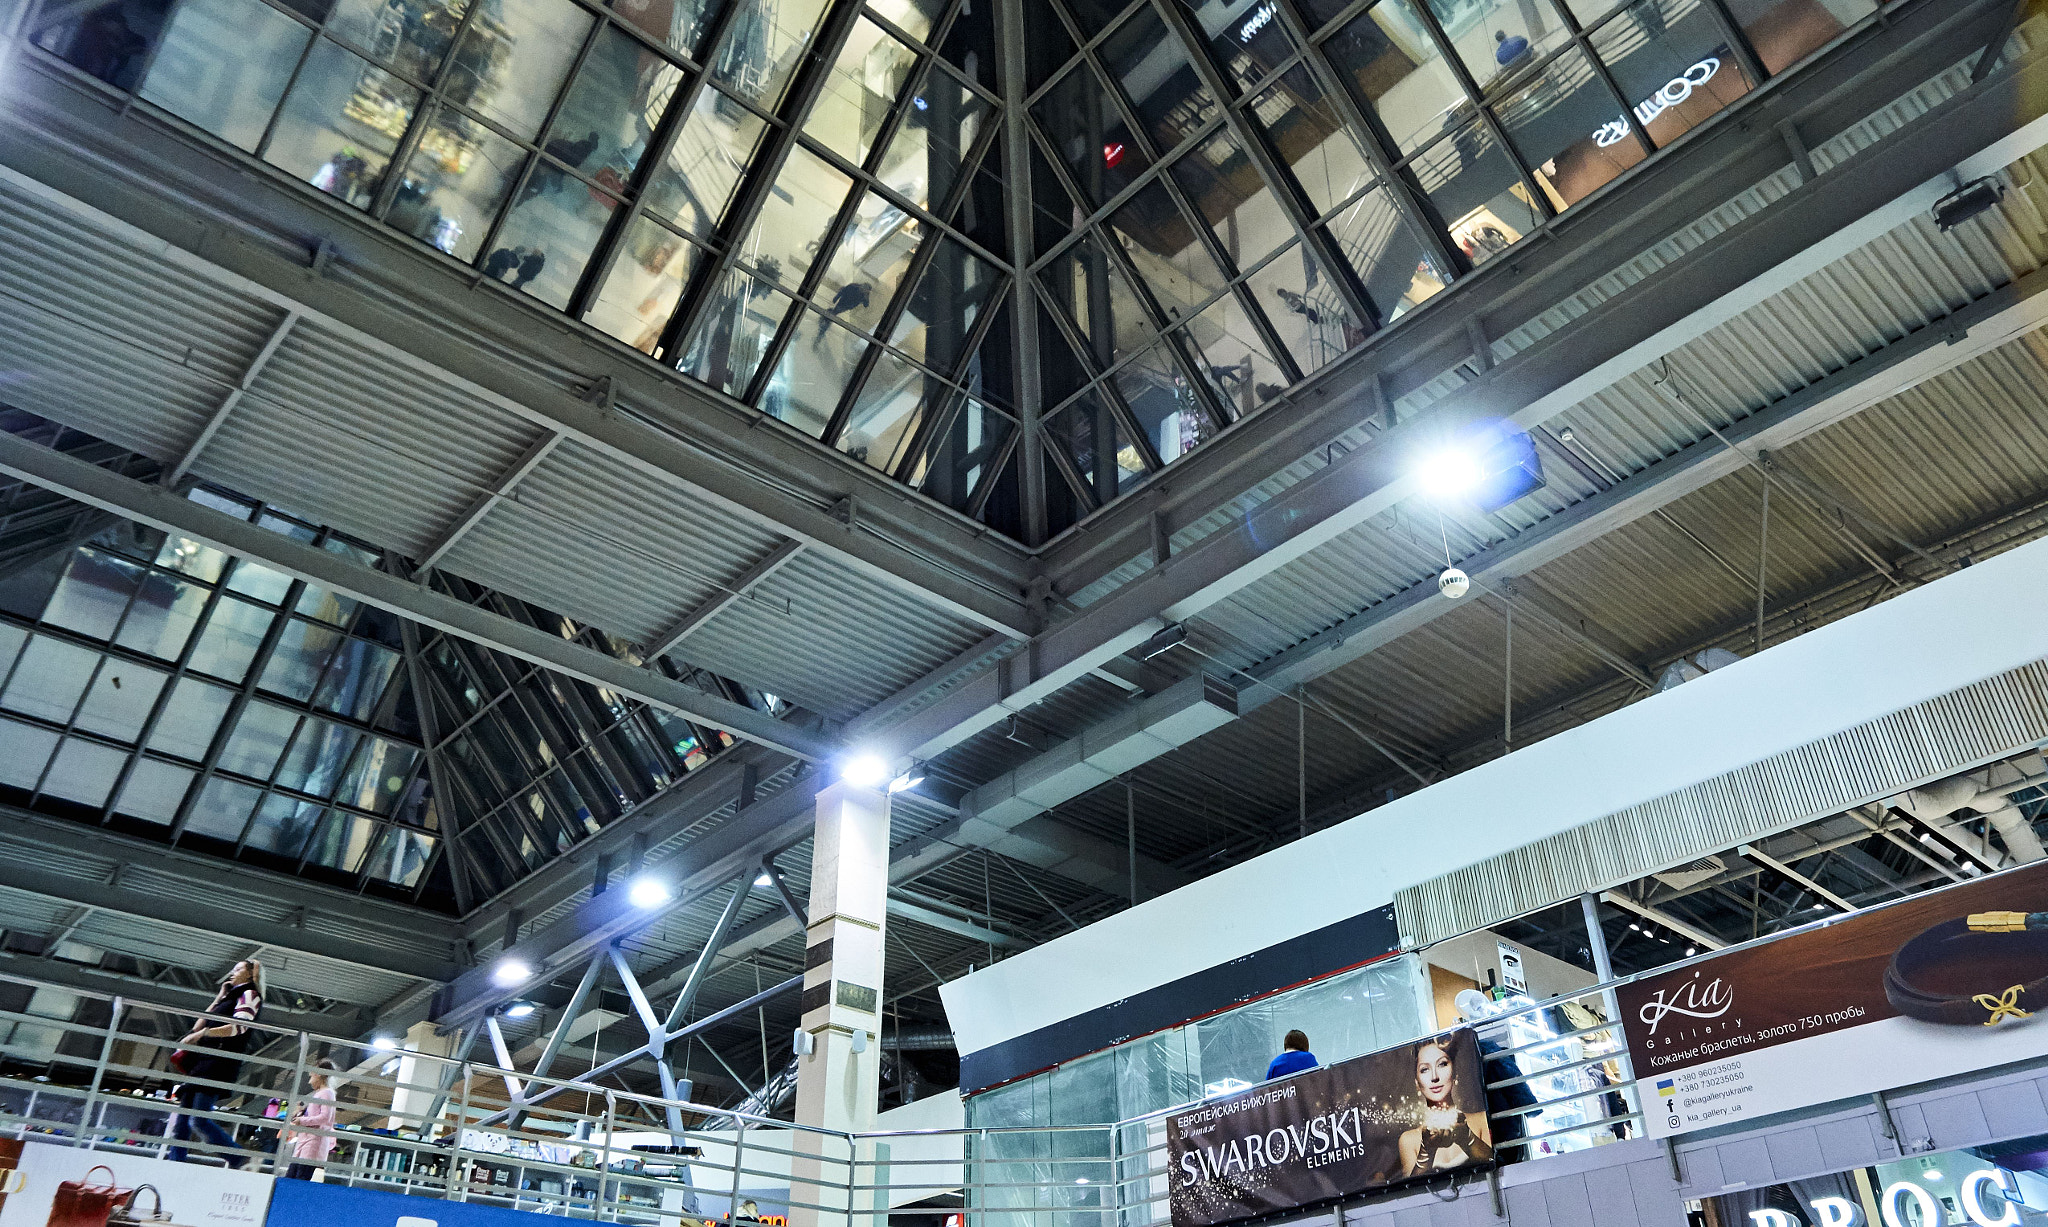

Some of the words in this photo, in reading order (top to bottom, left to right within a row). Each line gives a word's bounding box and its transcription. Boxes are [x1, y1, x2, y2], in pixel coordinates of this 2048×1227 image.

[1640, 971, 1733, 1036] Kia
[1646, 1018, 1741, 1049] Gallery
[1650, 1047, 1700, 1068] Кожаные
[1701, 1033, 1756, 1055] браслеты,
[1757, 1022, 1797, 1041] золото
[1798, 1014, 1823, 1031] 750
[1825, 1005, 1866, 1025] пробы
[1678, 1072, 1697, 1083] +380
[1698, 1061, 1742, 1079] 960235050
[1680, 1082, 1699, 1093] +380
[1701, 1071, 1745, 1089] 730235050
[1177, 1101, 1240, 1129] ЕВРОПЕЙСКАЯ
[1241, 1085, 1297, 1111] БИЖУТЕРИЯ
[1683, 1084, 1754, 1108] @kiagalleryukraine
[1687, 1104, 1742, 1122] kia_gallery_ua
[1180, 1107, 1363, 1187] SWAROVSKI
[1306, 1143, 1366, 1169] ELEMENTS
